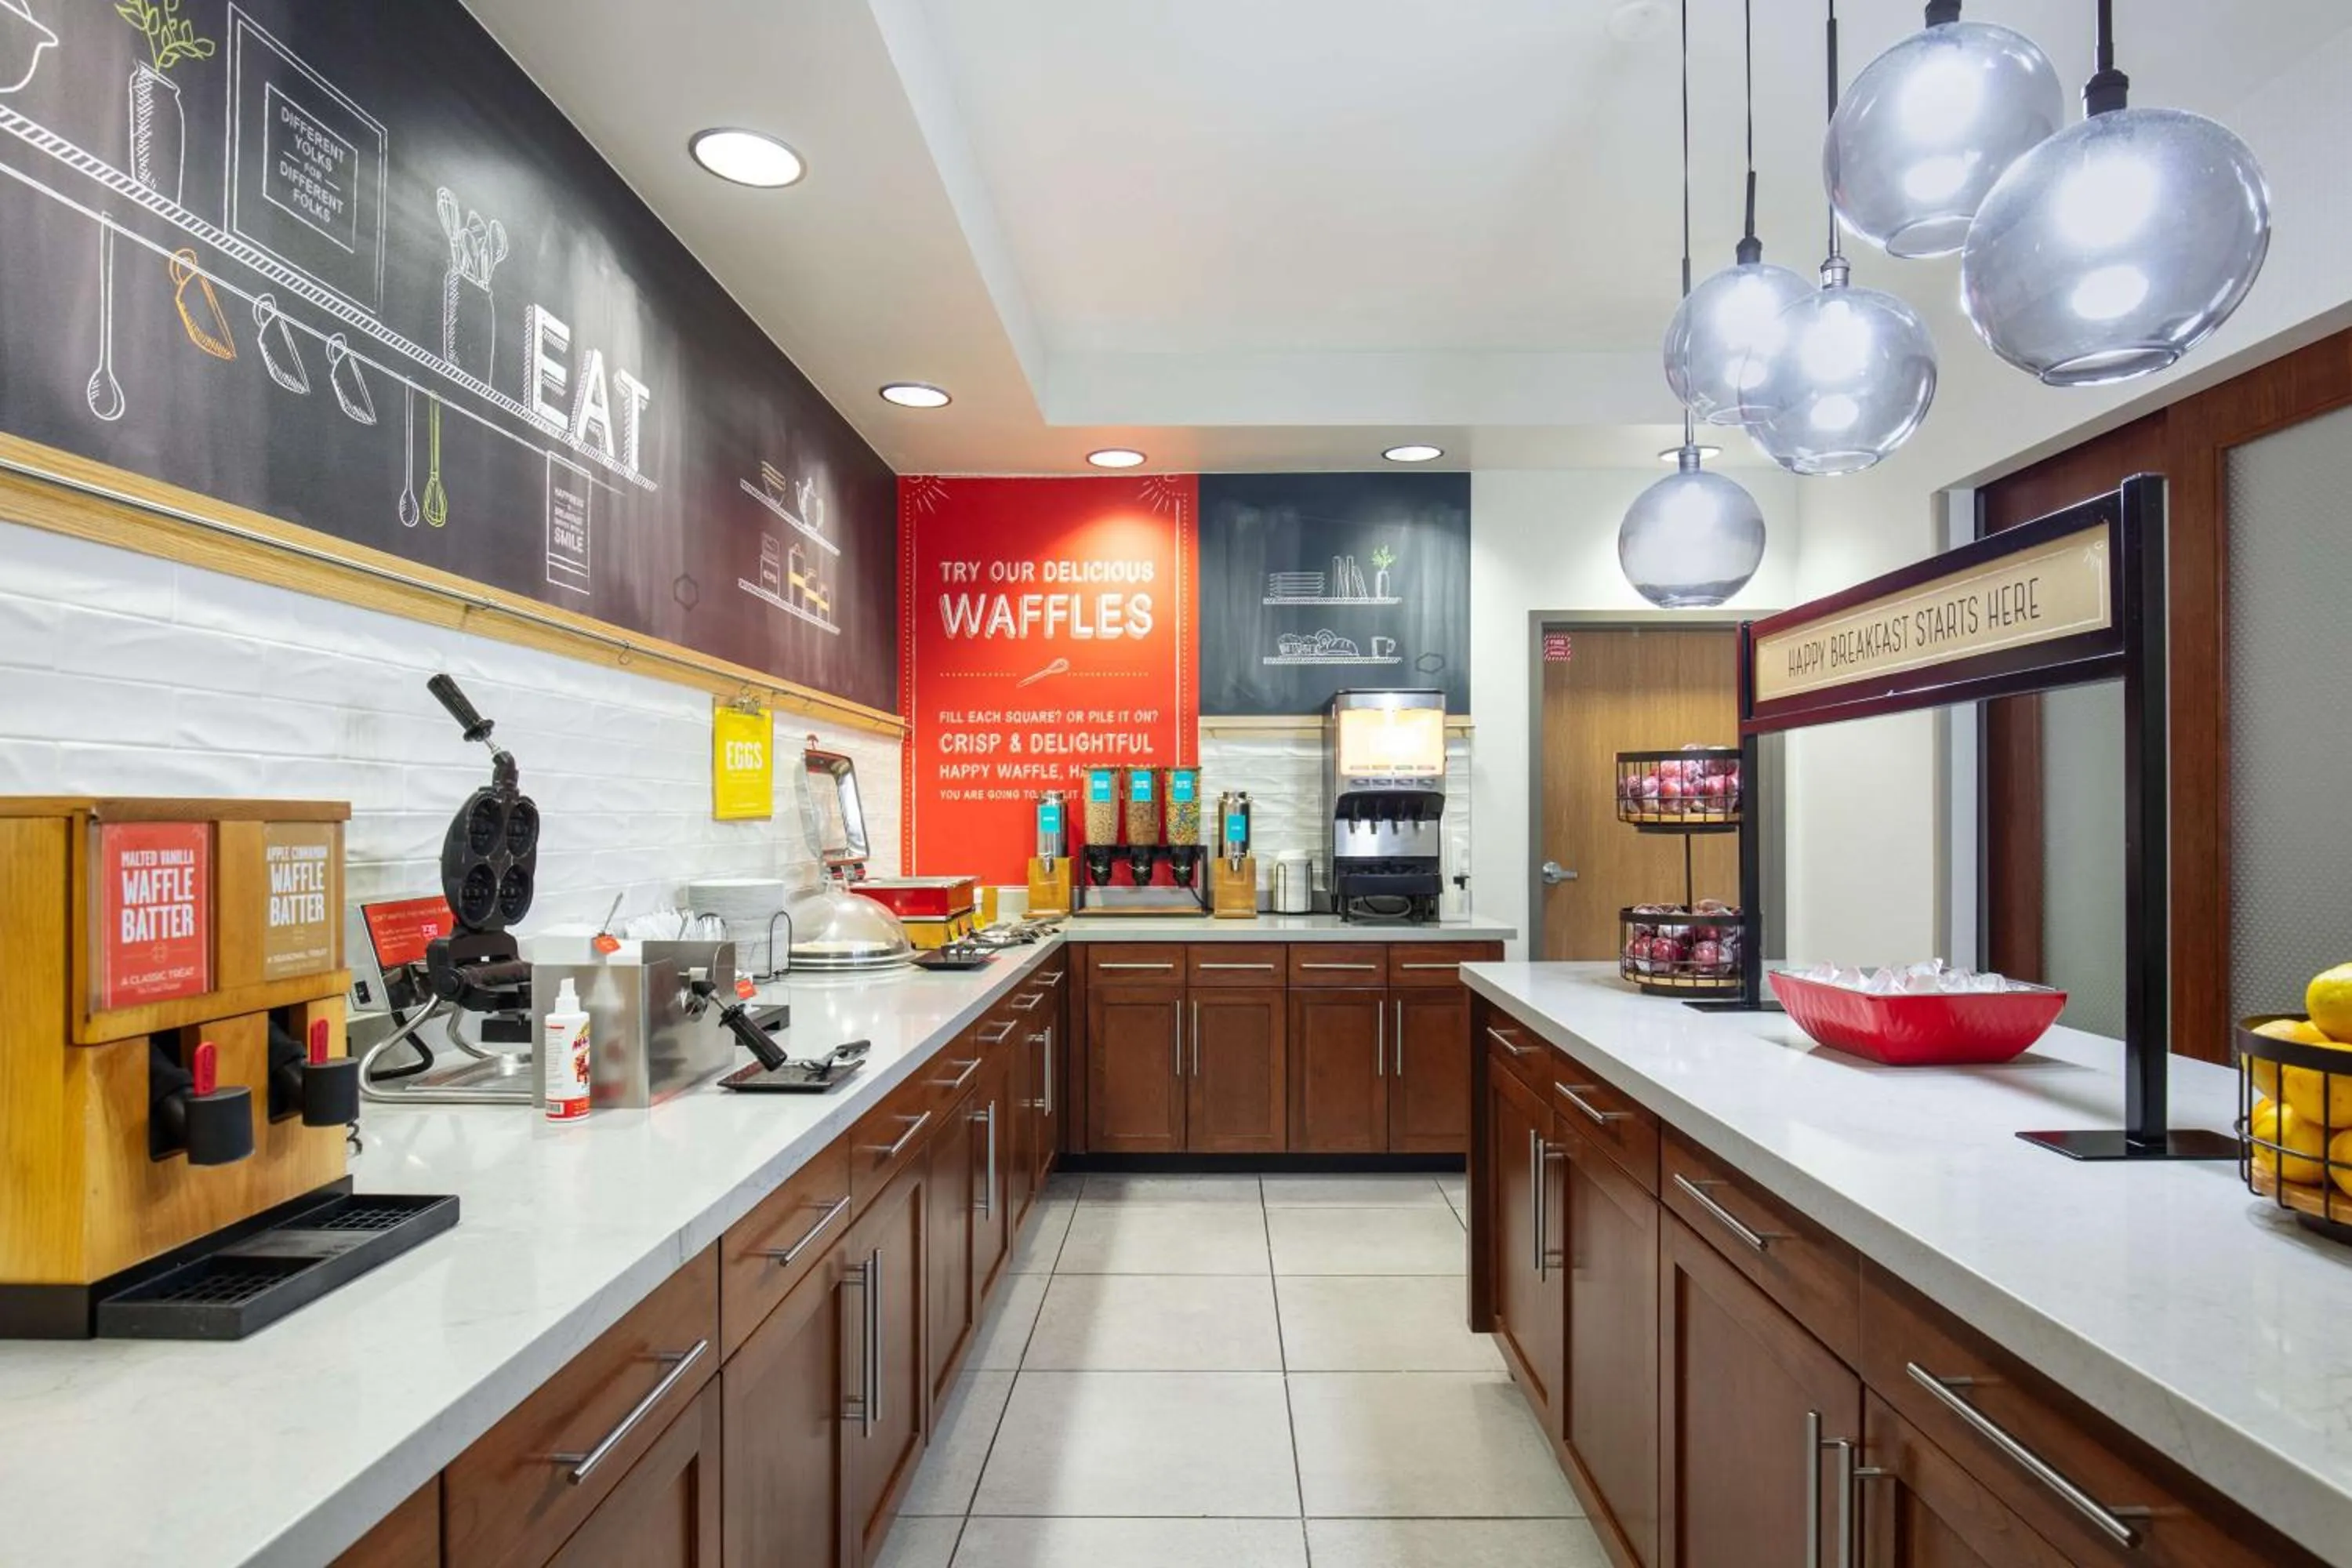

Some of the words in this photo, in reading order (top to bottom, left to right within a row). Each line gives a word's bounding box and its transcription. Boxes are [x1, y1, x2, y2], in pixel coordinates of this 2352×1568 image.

[281, 106, 345, 163] DIFFERENT
[295, 134, 332, 172] YOLKS
[279, 160, 344, 214] DIFFERENT
[303, 162, 322, 182] FOR
[292, 187, 331, 223] FOLKS
[524, 303, 651, 473] EAT
[554, 526, 584, 554] SMILE
[940, 561, 982, 583] TRY
[989, 561, 1035, 583] OUR
[1043, 561, 1155, 583] DELICIOUS
[940, 593, 1154, 640] WAFFLES
[1788, 640, 1827, 678] HAPPY
[1831, 615, 1910, 668] BREAKFAST
[1916, 595, 1979, 647] STARTS
[1988, 576, 2041, 629] HERE
[939, 711, 964, 723] FILL
[968, 711, 1001, 723] EACH
[1005, 710, 1062, 724] SQUARE?
[1066, 711, 1085, 723] OR
[1088, 710, 1115, 723] PILE
[1118, 710, 1129, 722] IT
[1134, 710, 1159, 723] ON?
[726, 741, 763, 771] EGGS
[939, 733, 1001, 753] CRISP
[1008, 733, 1022, 753] &
[1030, 732, 1154, 753] DELIGHTFUL
[939, 764, 990, 779] HAPPY
[996, 763, 1064, 781] WAFFLE,
[940, 789, 960, 800] YOU
[963, 789, 984, 800] ARE
[987, 789, 1019, 800] GOING
[122, 850, 157, 867] MALTED
[160, 849, 194, 866] VANILLA
[122, 868, 194, 905] WAFFLE
[270, 862, 325, 894] WAFFLE
[122, 904, 194, 944] BATTER
[270, 894, 325, 927] BATTER
[121, 977, 128, 987] A
